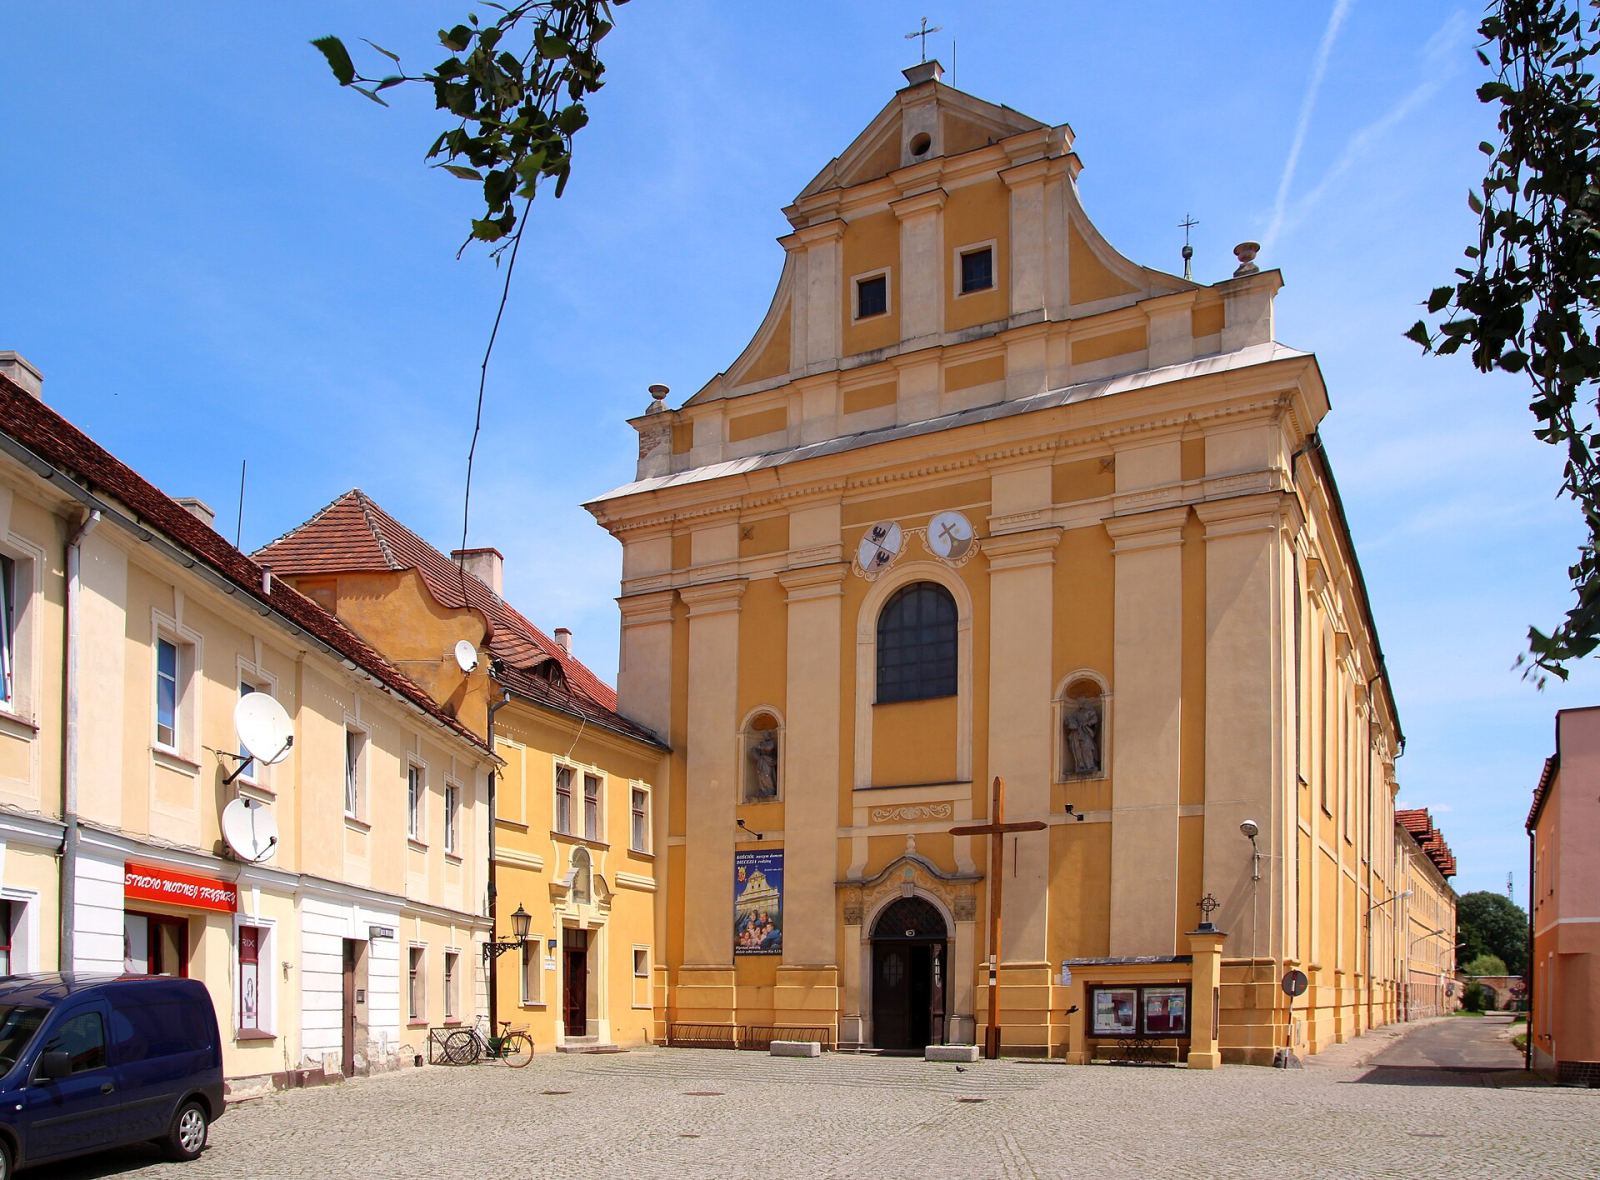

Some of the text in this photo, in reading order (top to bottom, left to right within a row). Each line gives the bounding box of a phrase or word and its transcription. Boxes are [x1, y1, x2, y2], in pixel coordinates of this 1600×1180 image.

[124, 874, 236, 904] STUDIO MODNEJ FRYZURY
